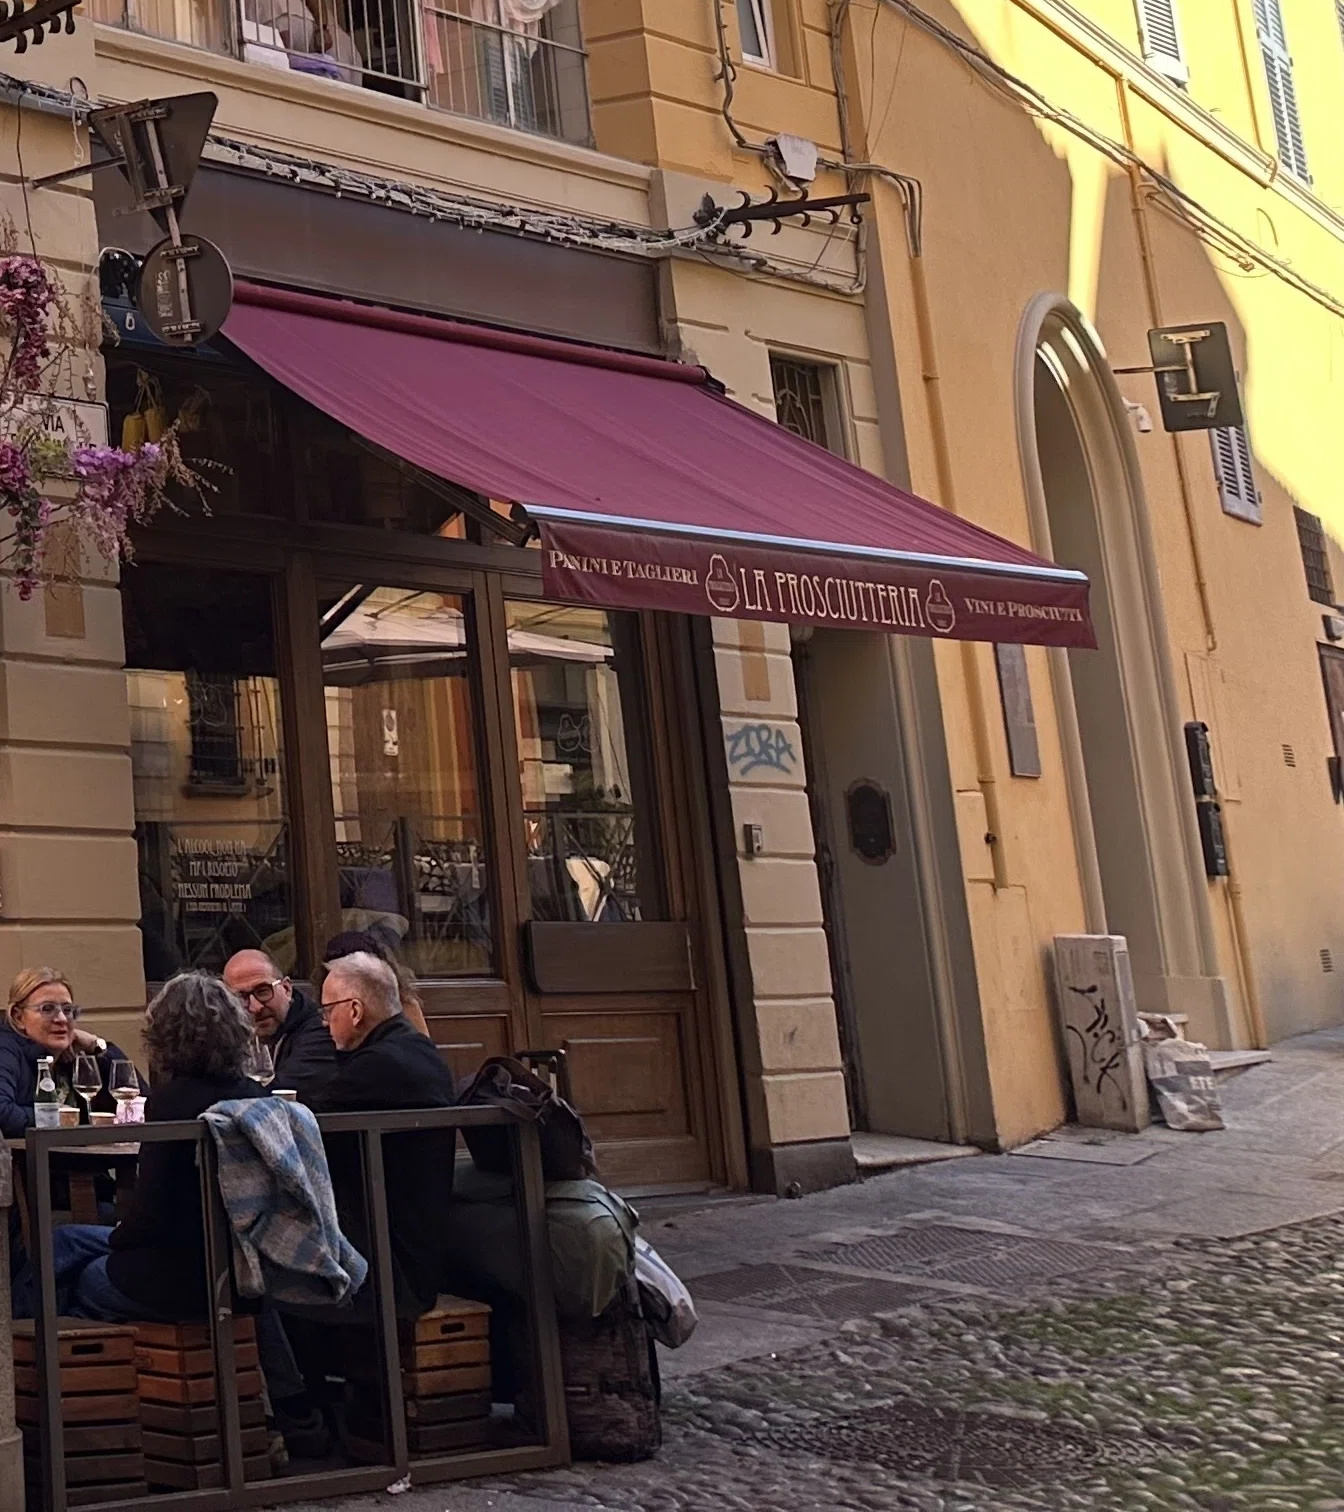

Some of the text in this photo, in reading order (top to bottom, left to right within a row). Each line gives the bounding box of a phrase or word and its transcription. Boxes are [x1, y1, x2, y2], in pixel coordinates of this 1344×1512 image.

[548, 550, 699, 585] PANINI E TAGLIERI
[739, 567, 772, 613] LA
[774, 571, 927, 629] PROSCIUTTERIA
[963, 597, 995, 615] VINI
[996, 602, 1006, 616] E
[1006, 601, 1083, 622] PROSCIUTTI
